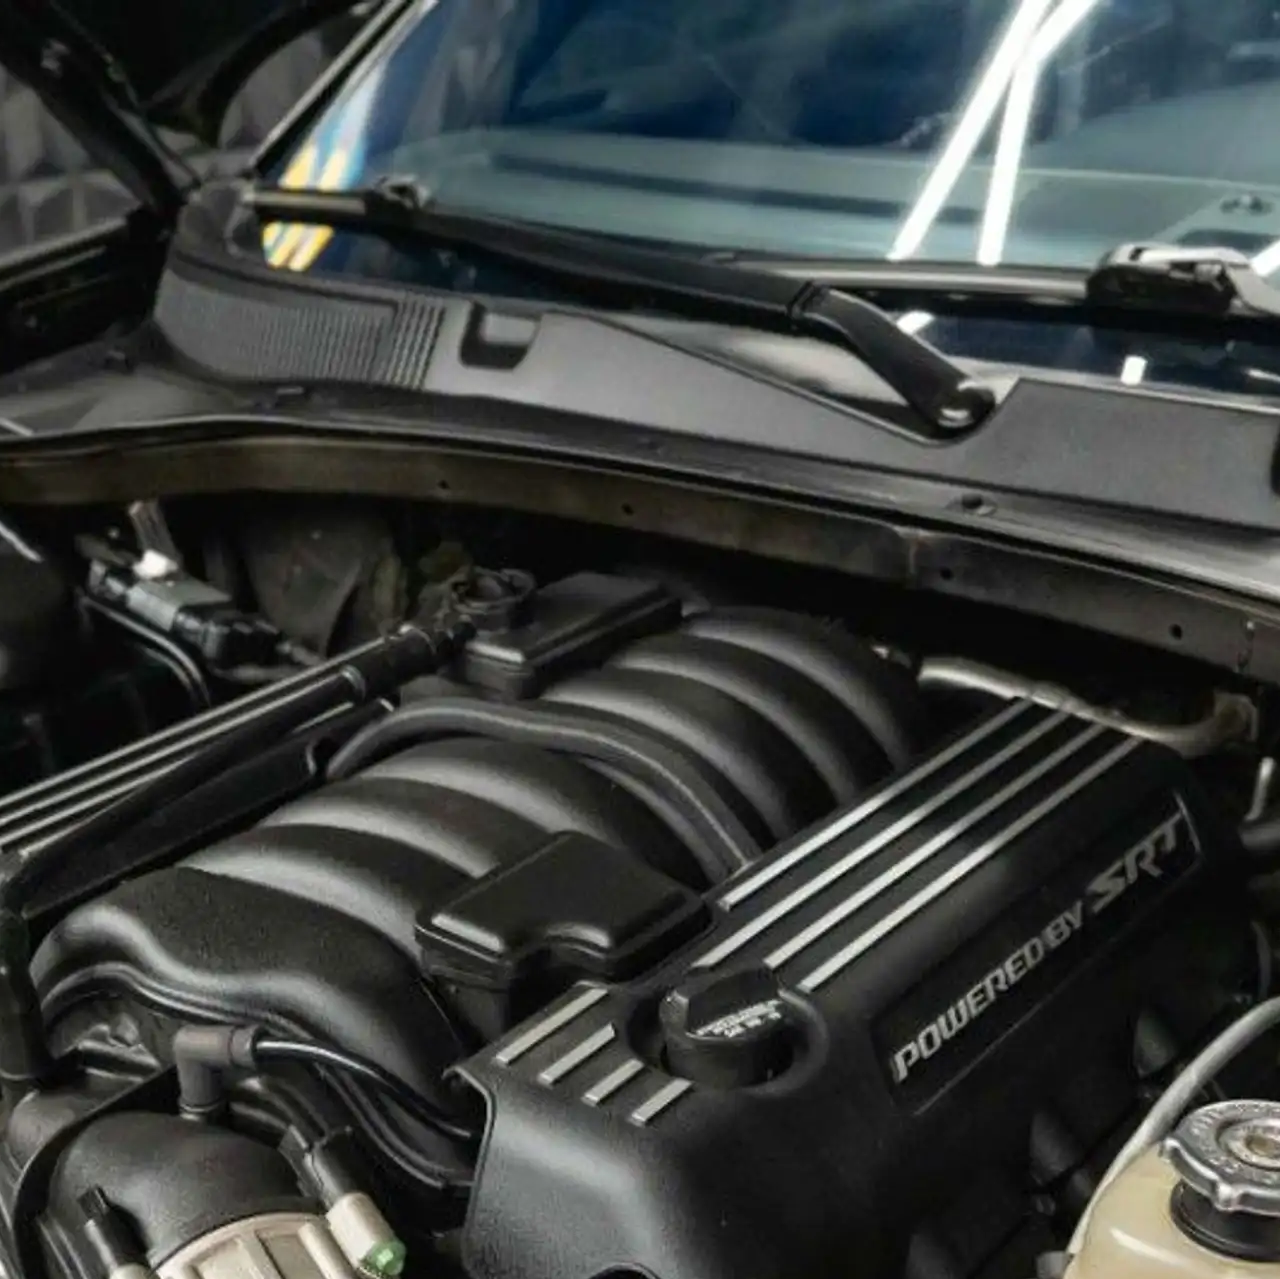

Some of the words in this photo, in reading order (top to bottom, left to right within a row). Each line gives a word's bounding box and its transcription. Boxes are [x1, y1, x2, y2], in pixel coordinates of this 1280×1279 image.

[891, 936, 1045, 1084] POWERED
[1040, 900, 1084, 948] BY
[1086, 809, 1183, 914] SRT
